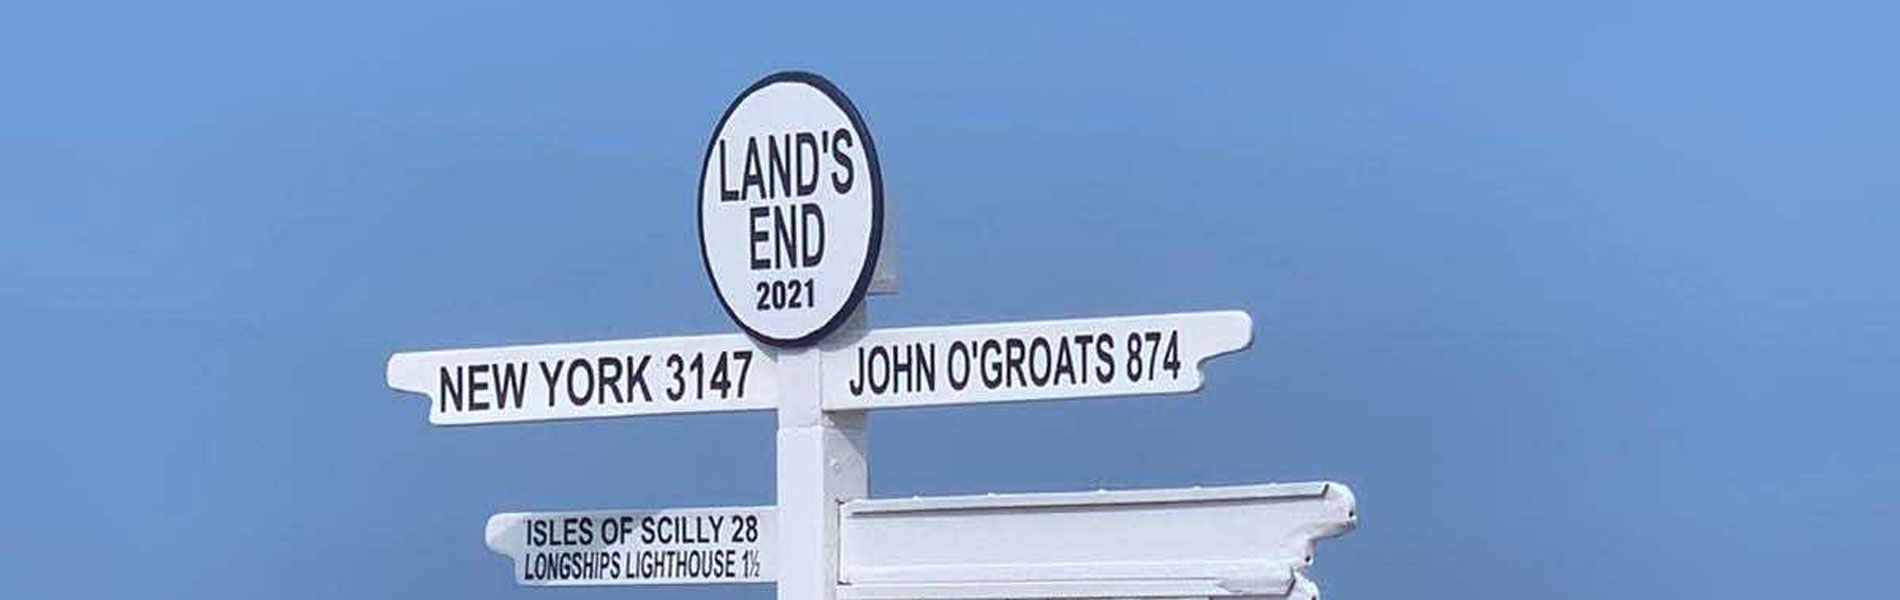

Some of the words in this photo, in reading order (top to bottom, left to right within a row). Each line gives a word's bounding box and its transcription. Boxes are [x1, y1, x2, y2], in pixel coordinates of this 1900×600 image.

[719, 128, 854, 202] LAND'S
[750, 203, 825, 270] END
[756, 278, 815, 310] 2021
[440, 361, 528, 413] NEW
[539, 354, 653, 408] YORK
[666, 351, 754, 402] 3147
[849, 342, 936, 397] JOHN
[947, 333, 1115, 391] O'GROATS
[1127, 330, 1182, 383] 874
[526, 517, 594, 546] ISLES
[601, 516, 633, 545] OF
[641, 516, 724, 544] SCILLY
[731, 515, 758, 543] 28
[524, 551, 621, 580] LONGSHIPS
[626, 550, 736, 579] LIGHTHOUSE
